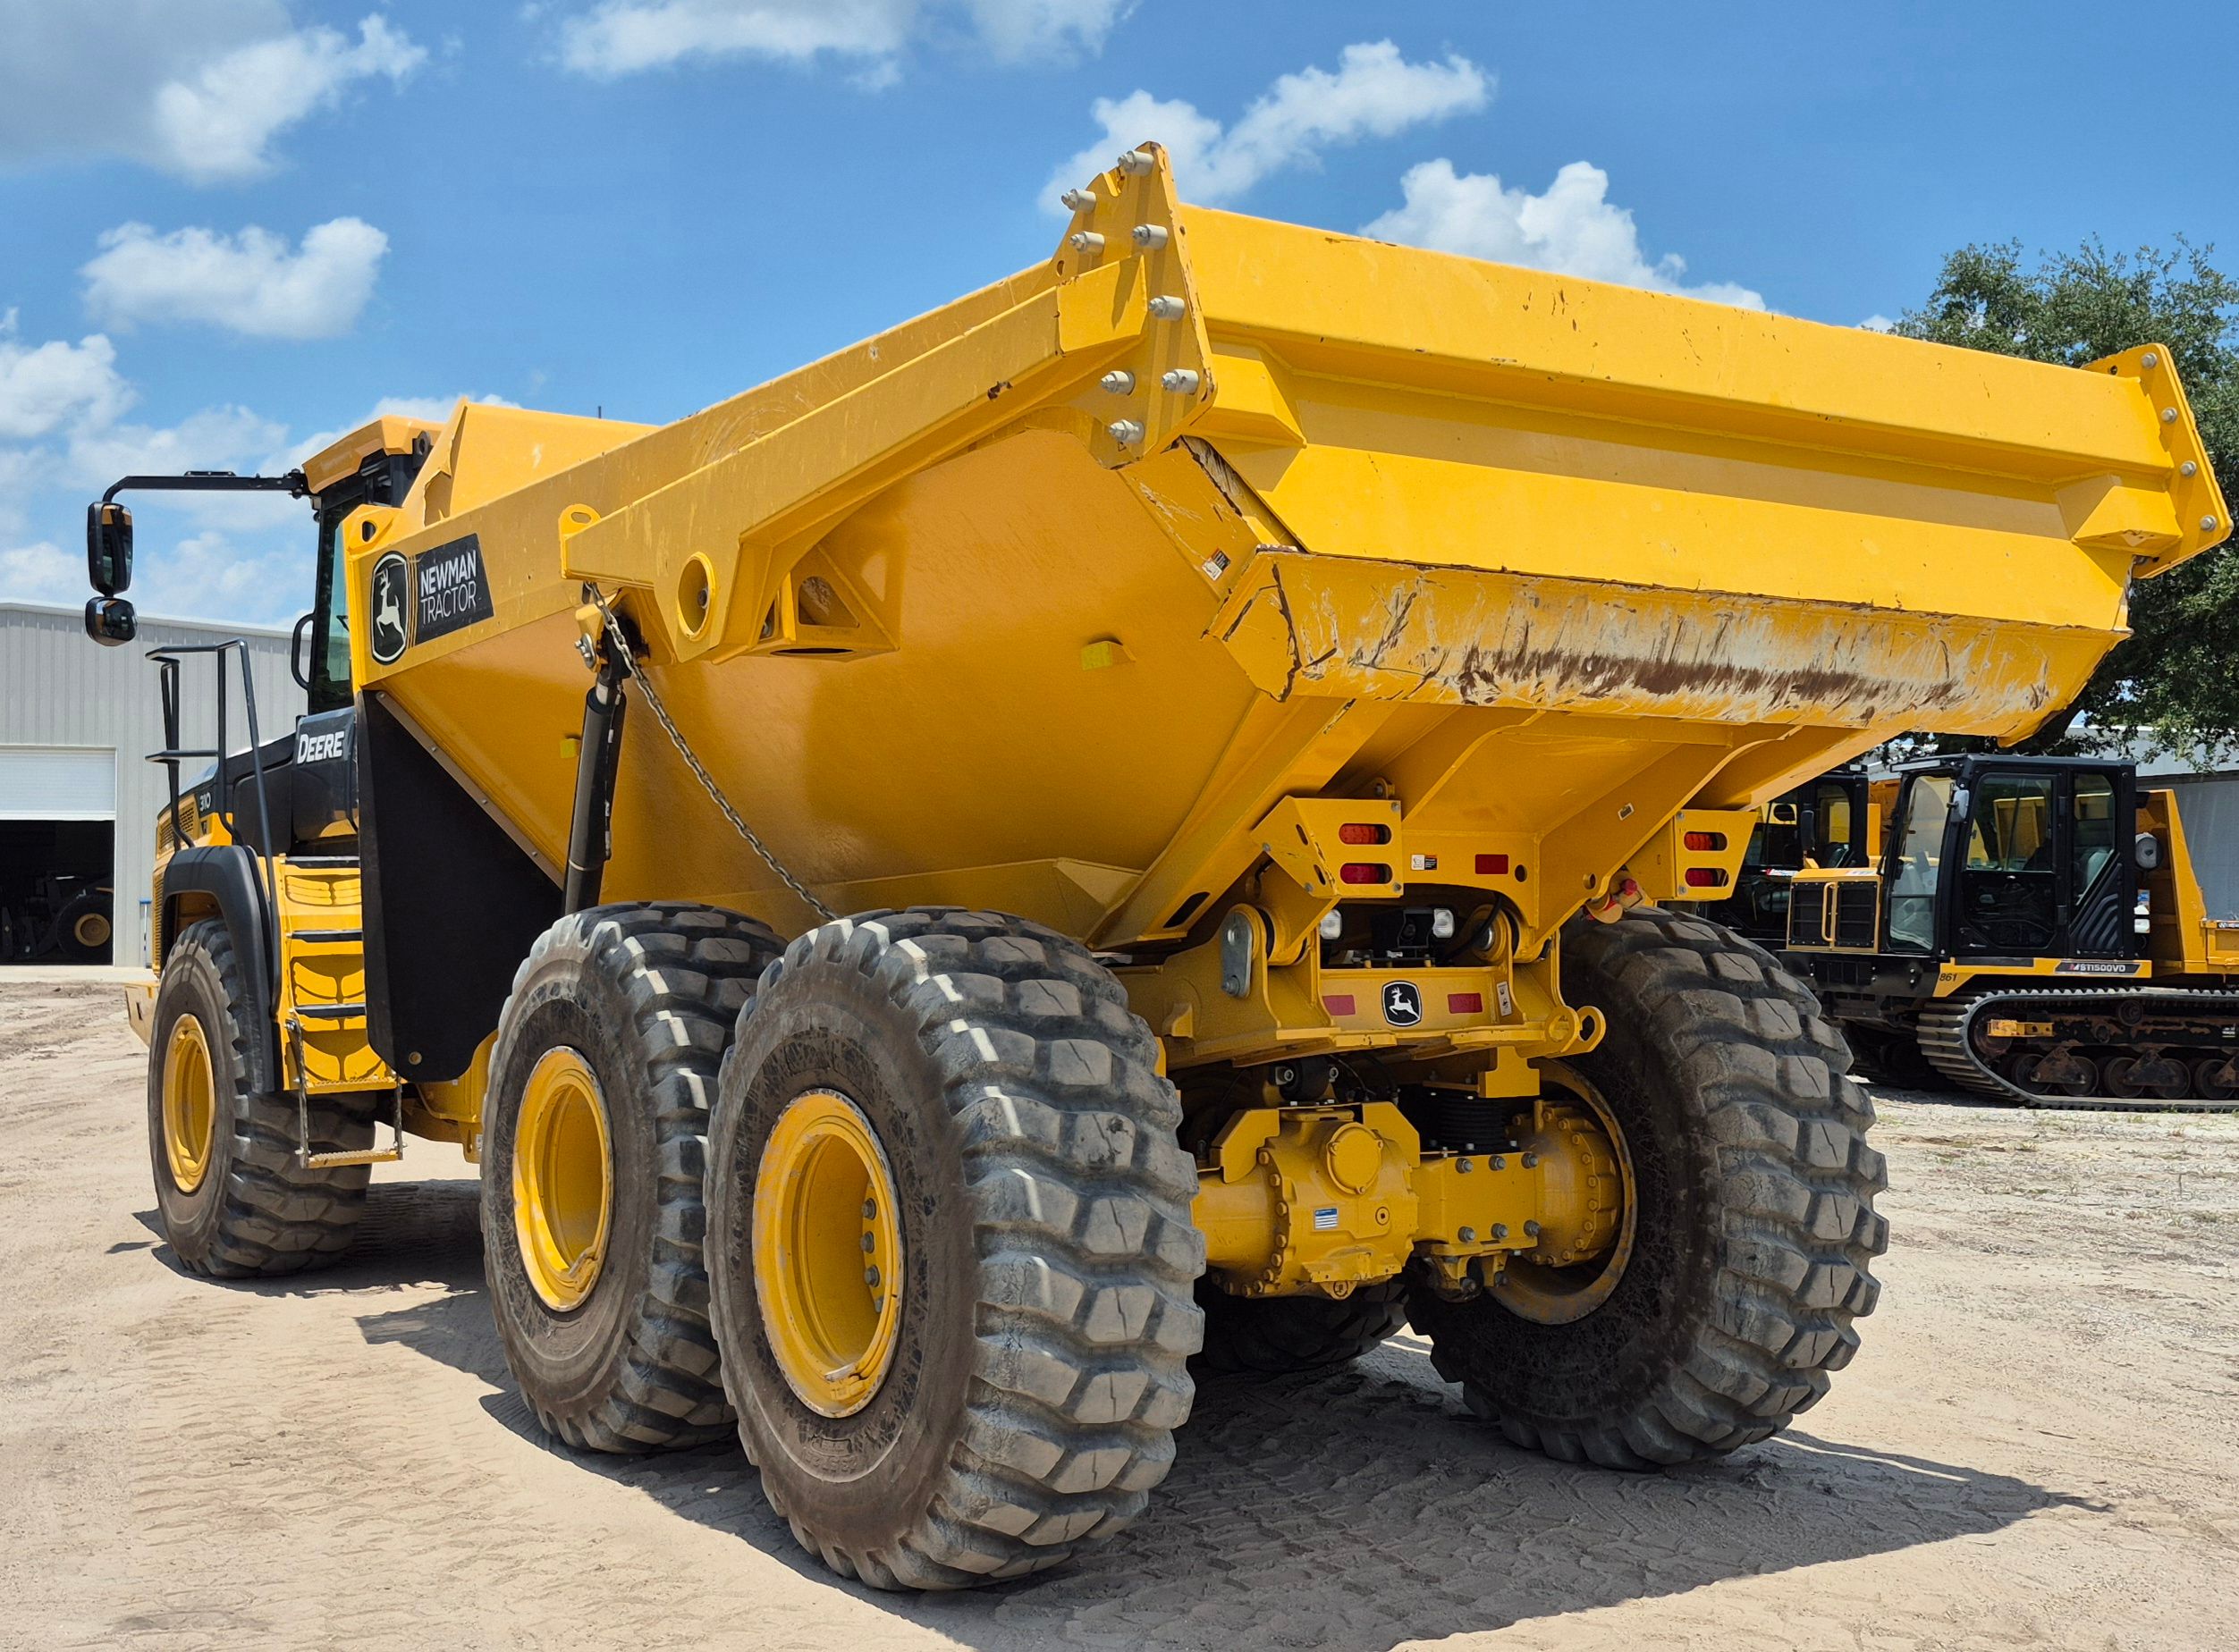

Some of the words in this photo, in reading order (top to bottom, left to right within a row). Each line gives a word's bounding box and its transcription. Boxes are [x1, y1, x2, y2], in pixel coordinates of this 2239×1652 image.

[420, 549, 477, 598] NEWMAN
[420, 580, 477, 625] TRACTOR
[297, 730, 345, 764] DEERE
[199, 791, 212, 812] 310
[1939, 973, 1957, 982] 861
